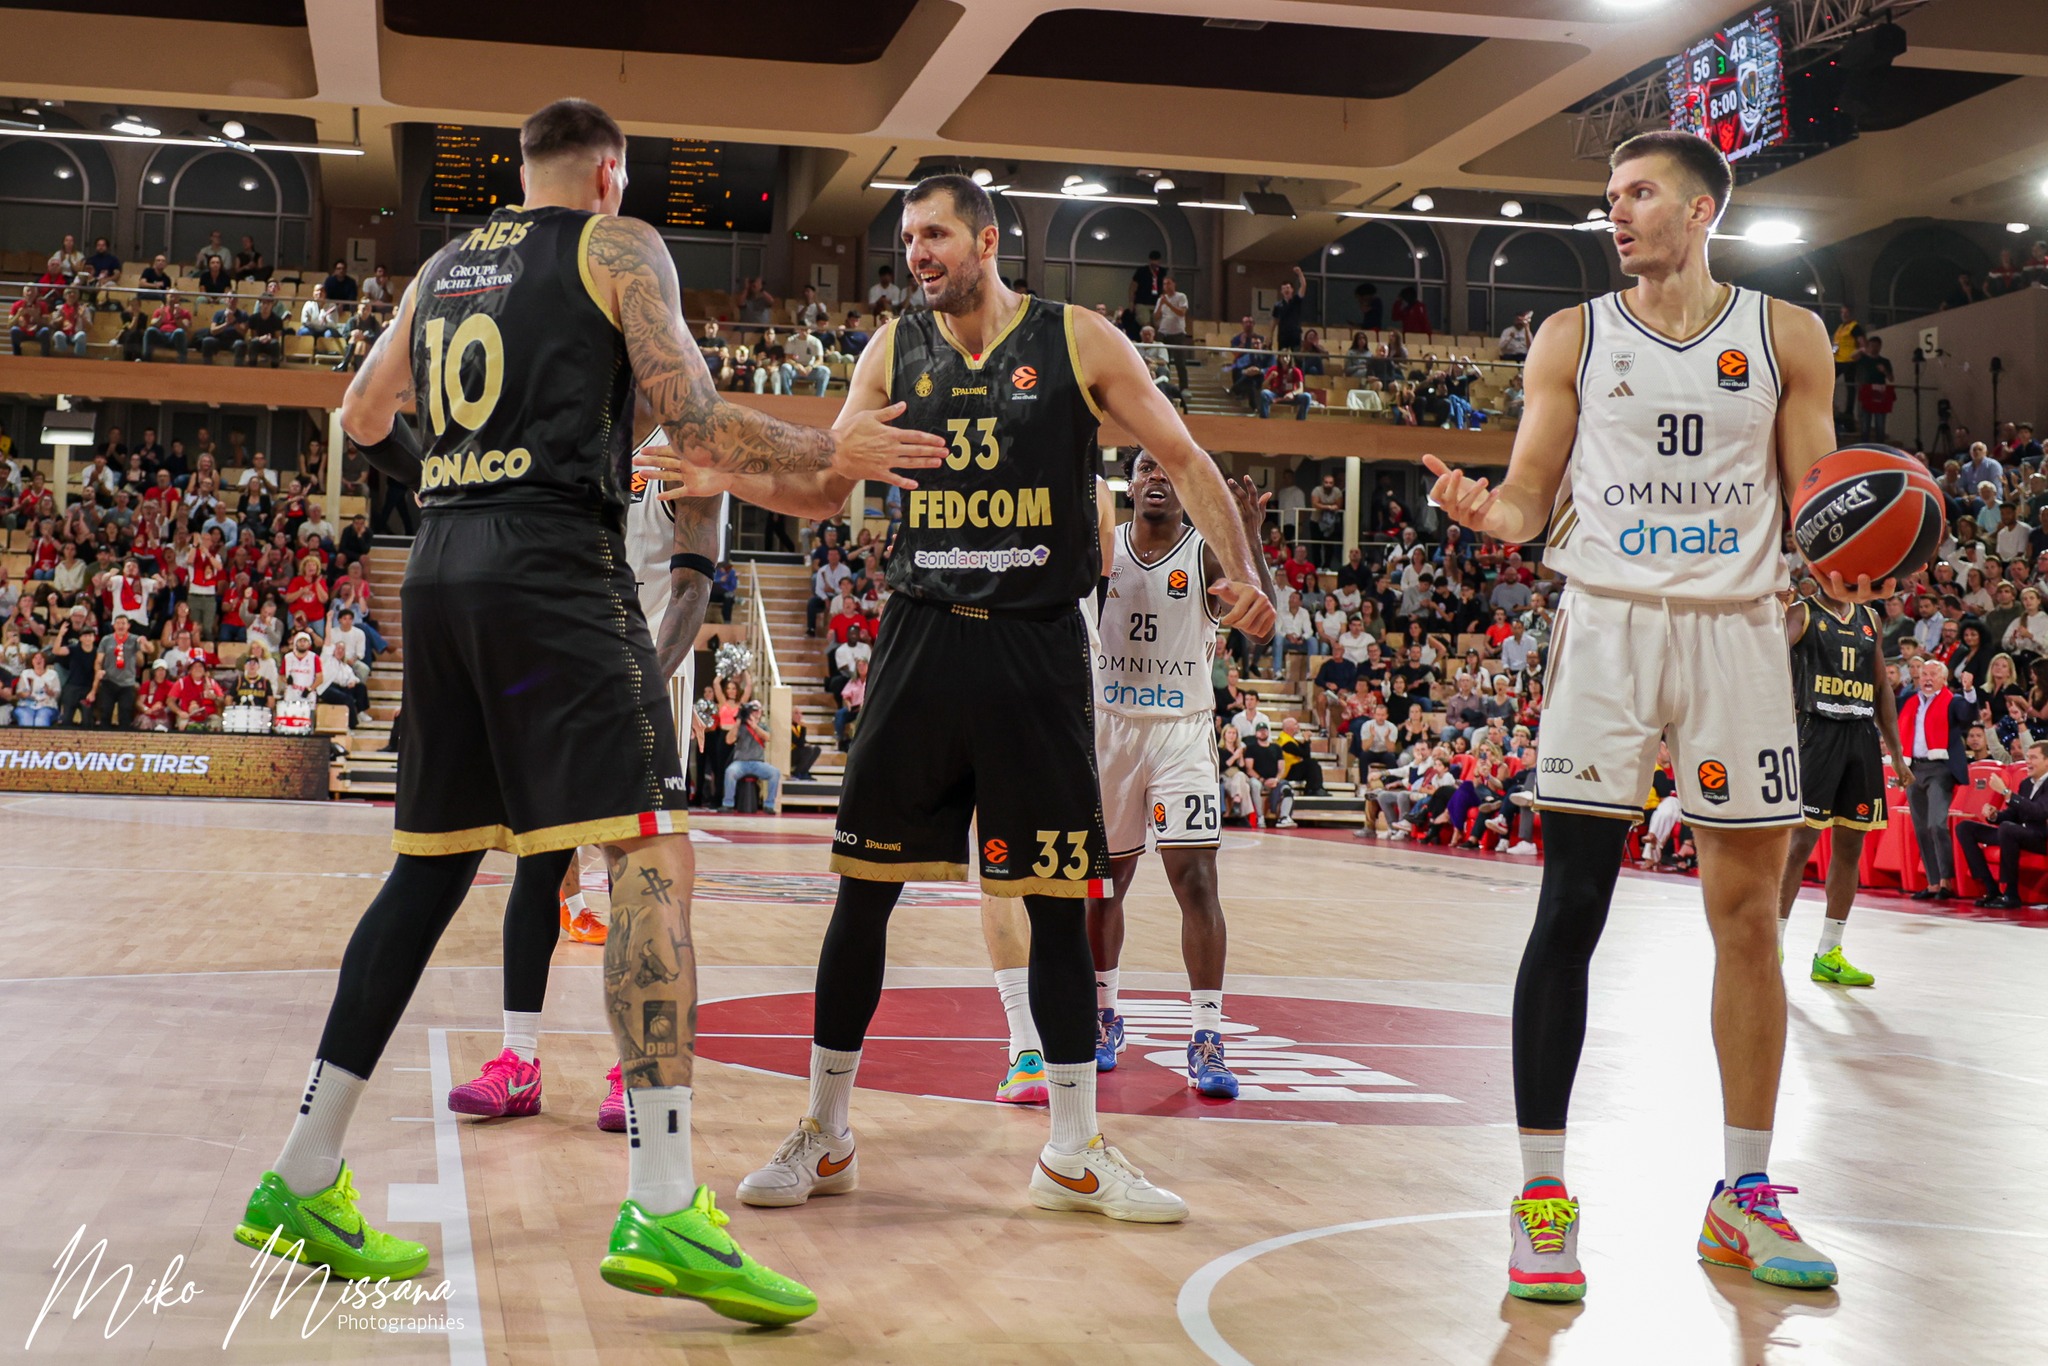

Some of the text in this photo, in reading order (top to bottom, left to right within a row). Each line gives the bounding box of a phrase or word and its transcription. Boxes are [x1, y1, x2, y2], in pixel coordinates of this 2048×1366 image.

[1730, 36, 1748, 62] 48
[1693, 56, 1710, 82] 56
[1717, 56, 1726, 75] 3
[1710, 90, 1737, 119] 8:00
[460, 221, 534, 251] THEIS
[354, 240, 368, 261] L
[817, 266, 831, 287] L
[1258, 290, 1270, 311] L
[1924, 333, 1934, 353] S
[426, 313, 504, 436] 10
[952, 386, 987, 397] SPALDING
[945, 417, 999, 471] 33
[1657, 413, 1704, 456] 30
[1257, 469, 1267, 489] J
[1603, 482, 1755, 506] OMNIYAT
[909, 487, 1053, 529] FEDCOM
[1796, 479, 1877, 552] SPALDING
[1619, 519, 1740, 556] dnata
[917, 549, 1031, 569] zondacrypto
[1129, 612, 1158, 643] 25
[1098, 655, 1196, 677] OMNIYAT
[1841, 646, 1856, 672] 11
[1104, 681, 1184, 708] dnata
[1814, 675, 1874, 702] FEDCOM
[0, 750, 210, 775] THMOVING TIRES
[1758, 746, 1798, 804] 30
[1184, 794, 1217, 830] 25
[1873, 798, 1882, 822] 11
[865, 839, 901, 852] SPALDING
[1032, 830, 1089, 880] 33
